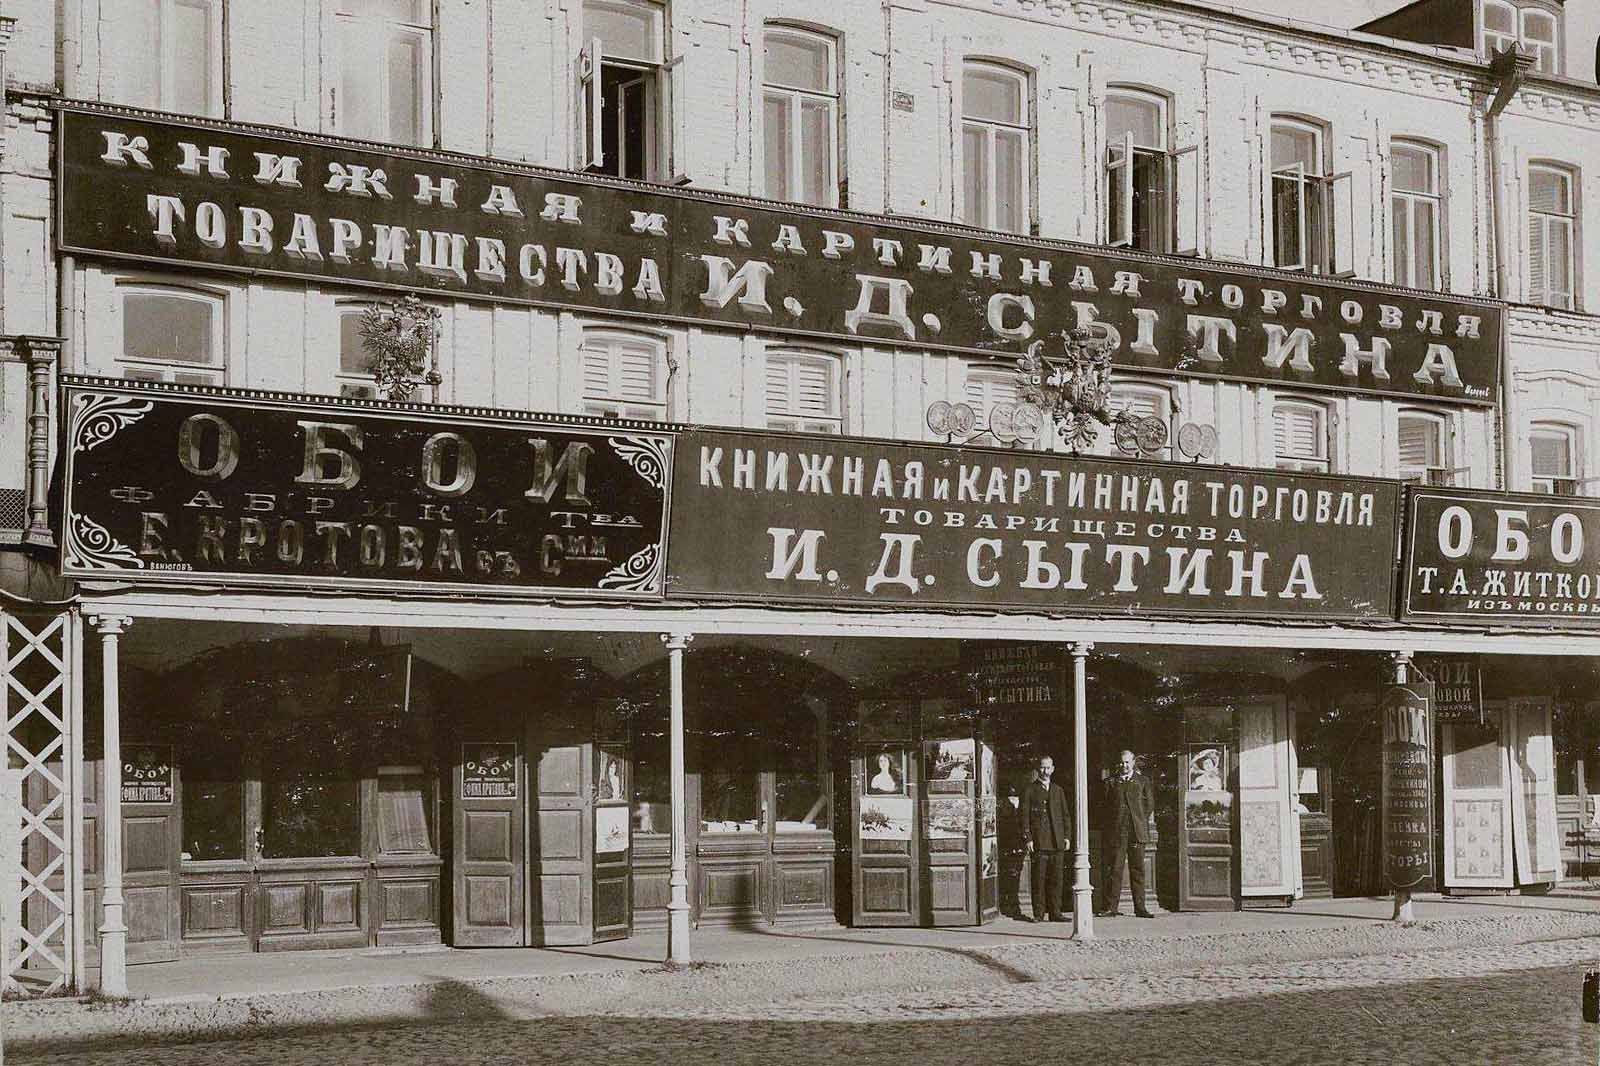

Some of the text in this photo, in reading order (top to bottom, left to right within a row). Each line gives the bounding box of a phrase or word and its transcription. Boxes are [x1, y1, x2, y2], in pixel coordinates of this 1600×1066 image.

[100, 130, 583, 225] КНИЖНАЯ
[712, 215, 1143, 298] КАРТИННАЯ
[1177, 278, 1482, 339] ТОРГОВЛЯ
[147, 194, 1464, 388] ТОВАРИЩЕСТВА И. Д. СЫТИНА
[178, 413, 595, 506] ОБОИ
[700, 446, 925, 499] КНИЖНАЯ
[958, 464, 1190, 515] КАРТИННАЯ
[1205, 481, 1375, 527] ТОРГОВЛЯ
[109, 486, 508, 525] ФАБРИКИ
[880, 508, 1247, 543] ТОВАРИЩЕСТВА
[1438, 506, 1600, 566] ОБО
[765, 527, 1323, 600] И. Д. СЫТИНА
[124, 762, 169, 779] ОБОИ
[466, 760, 513, 775] ОБОИ
